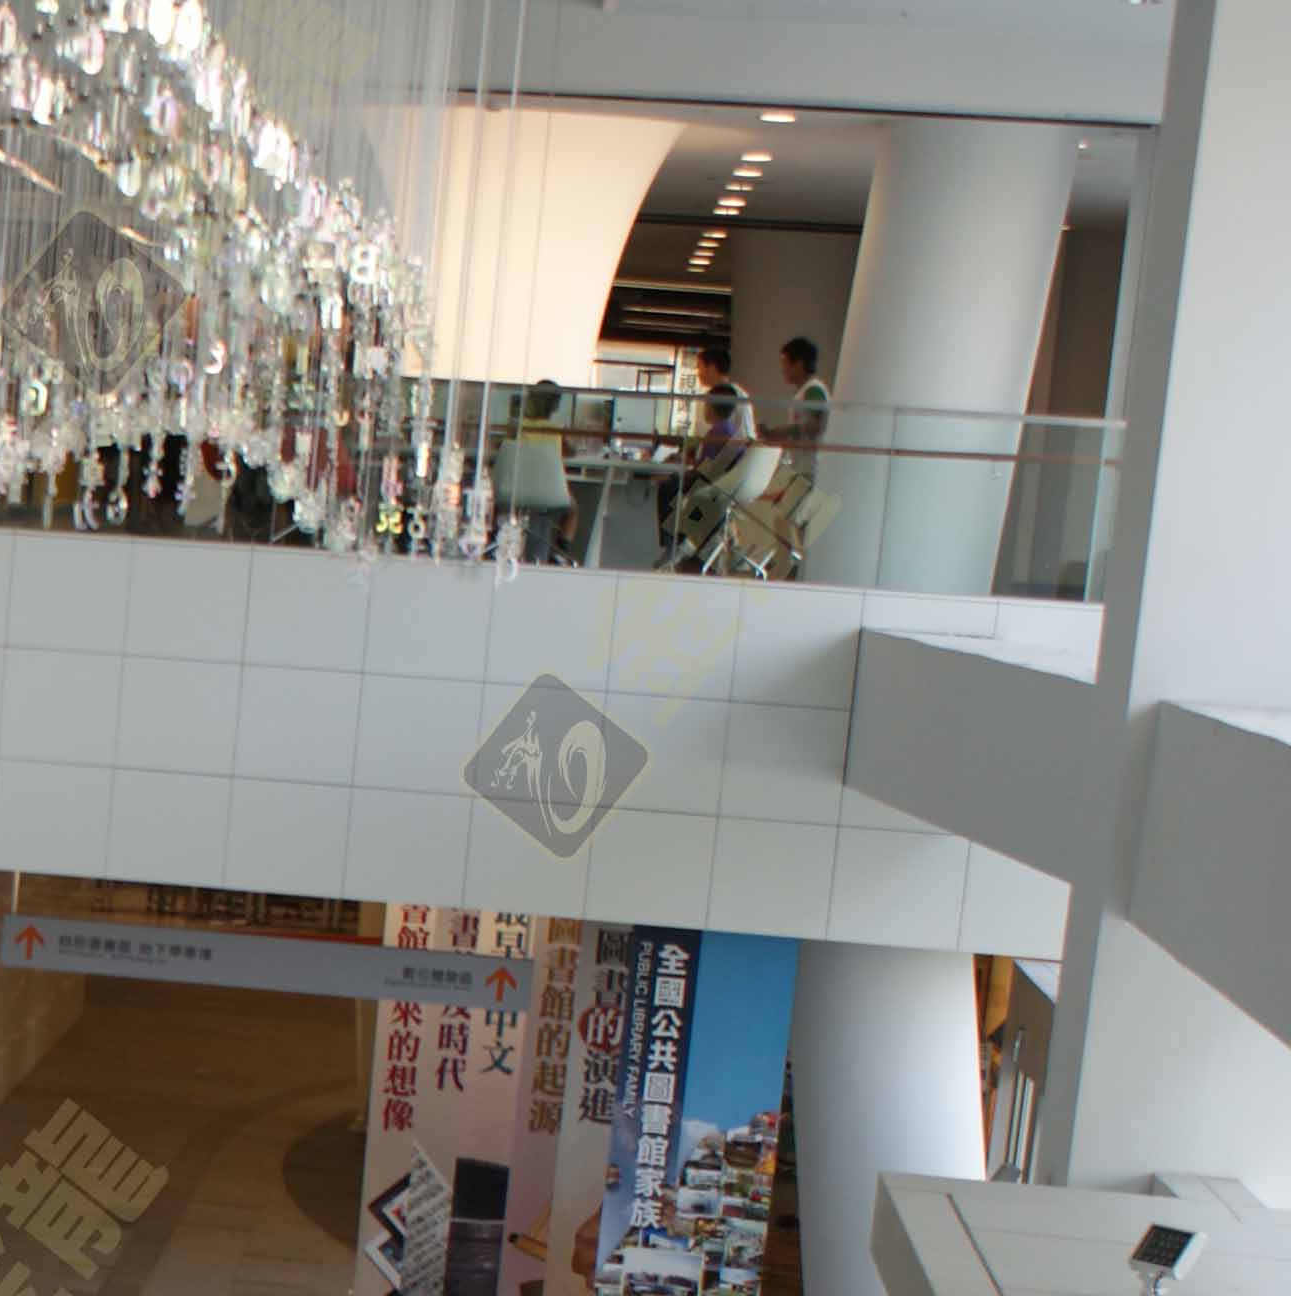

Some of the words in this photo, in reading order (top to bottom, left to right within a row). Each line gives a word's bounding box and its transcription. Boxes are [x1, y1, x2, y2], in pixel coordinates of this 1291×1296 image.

[630, 943, 690, 1229] 全國公共圖書館家族
